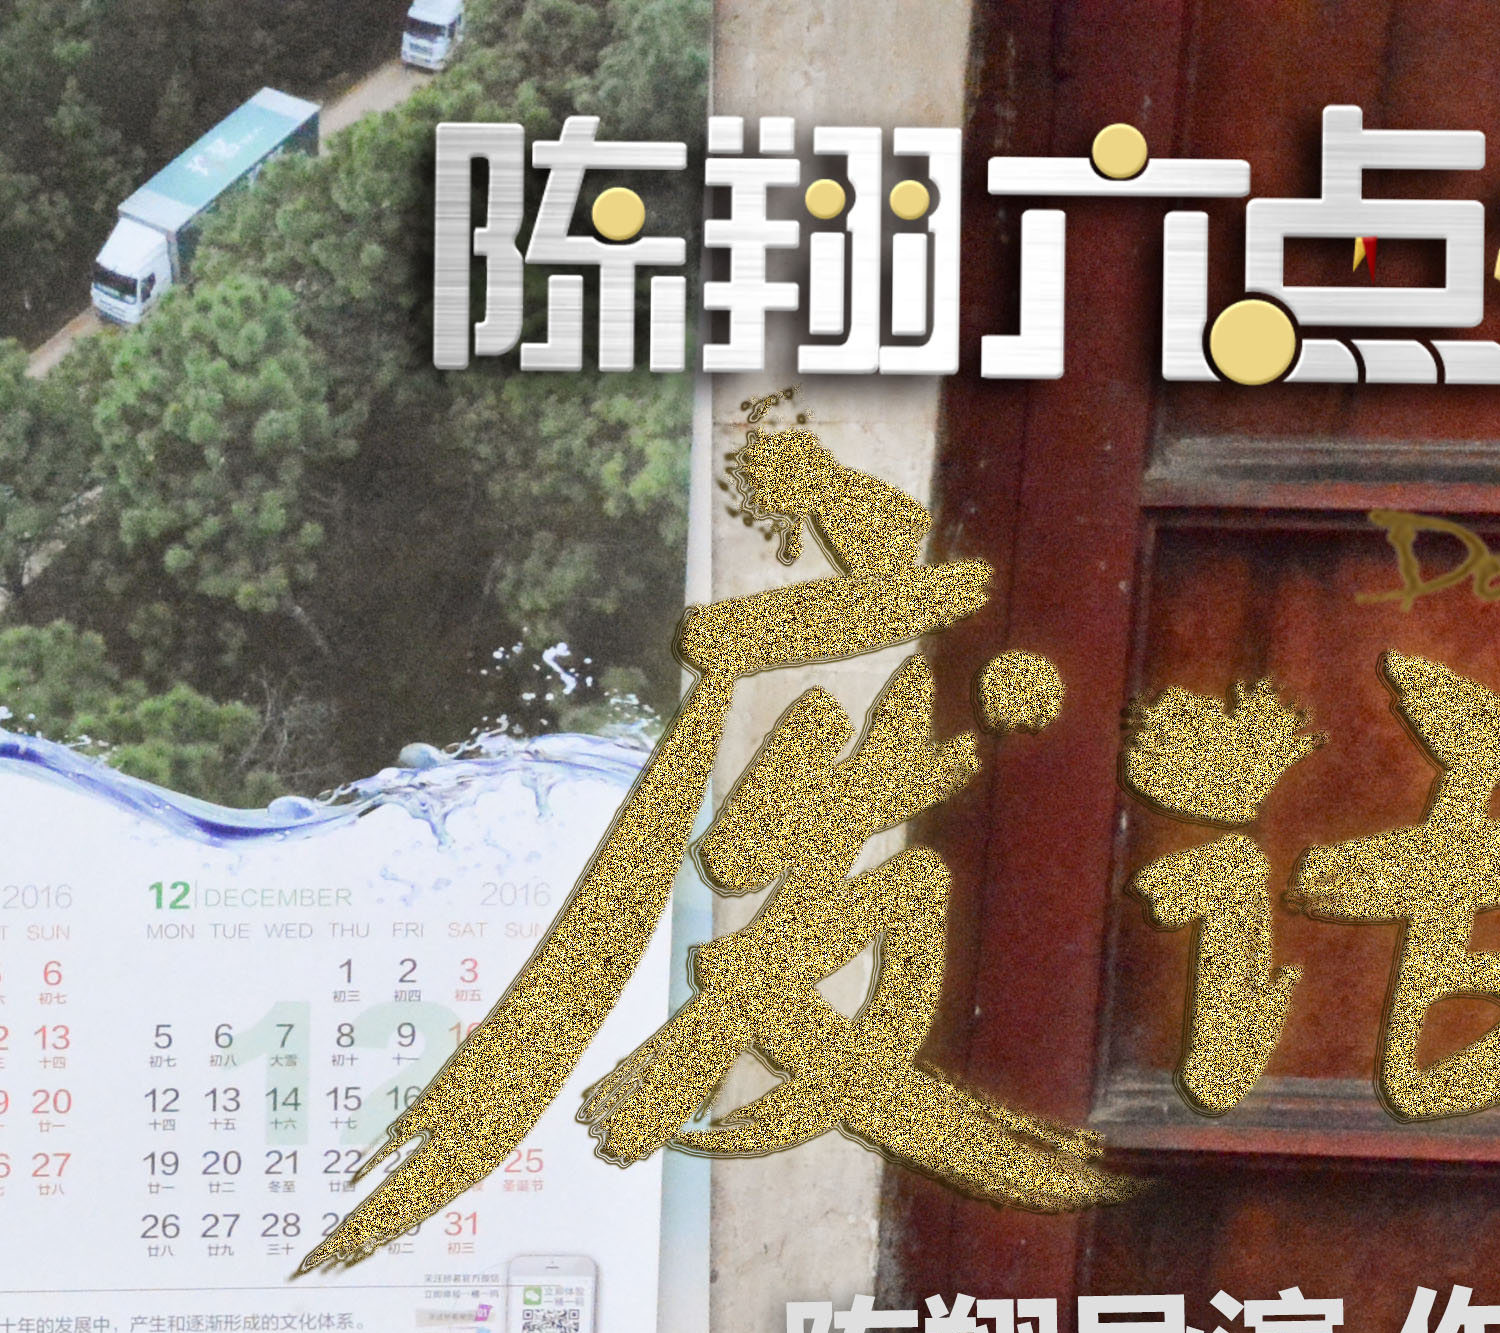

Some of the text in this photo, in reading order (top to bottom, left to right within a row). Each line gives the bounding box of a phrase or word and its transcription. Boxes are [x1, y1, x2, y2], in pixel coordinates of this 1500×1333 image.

[2, 884, 72, 909] 2016
[149, 881, 550, 909] 12 DECEMBER 2016
[27, 925, 70, 941] SUN
[147, 923, 194, 939] MON
[210, 923, 249, 939] TUE
[264, 923, 313, 939] WED
[330, 922, 370, 938] THU
[393, 922, 424, 938] FRI
[448, 922, 487, 938] SAT
[43, 961, 62, 986] 6
[340, 958, 478, 983] 1 2 3
[39, 992, 66, 1005] 初七
[333, 989, 482, 1002] 初三 初四 初五
[35, 1025, 70, 1050] 13
[155, 1024, 172, 1049] 5
[215, 1024, 233, 1048] 6
[276, 1024, 294, 1048] 7
[336, 1023, 355, 1048] 8
[397, 1022, 415, 1047] 9
[39, 1056, 66, 1069] 十四
[150, 1053, 419, 1068] 初七 初八 大雪 初十 十一
[32, 1089, 72, 1114] 20
[145, 1088, 179, 1112] 12
[205, 1088, 240, 1112] 13
[266, 1087, 301, 1111] 14
[327, 1087, 361, 1111] 15
[38, 1120, 65, 1132] 廿一
[149, 1117, 357, 1131] 十四 十五 十六 十七
[32, 1153, 71, 1177] 27
[144, 1151, 179, 1175] 19
[202, 1151, 241, 1175] 20
[265, 1150, 297, 1174] 21
[323, 1149, 361, 1174] 22
[504, 1149, 543, 1173] 25
[38, 1184, 64, 1195] 廿八
[148, 1182, 174, 1194] 廿一
[208, 1181, 235, 1193] 廿二
[269, 1181, 295, 1193] 冬至
[503, 1179, 544, 1192] 圣诞节
[141, 1214, 180, 1238] 26
[201, 1214, 240, 1238] 27
[261, 1213, 300, 1237] 28
[444, 1211, 478, 1235] 31
[147, 1244, 173, 1257] 廿八
[208, 1244, 234, 1256] 廿九
[267, 1243, 294, 1255] 三十
[448, 1239, 474, 1254] 初三
